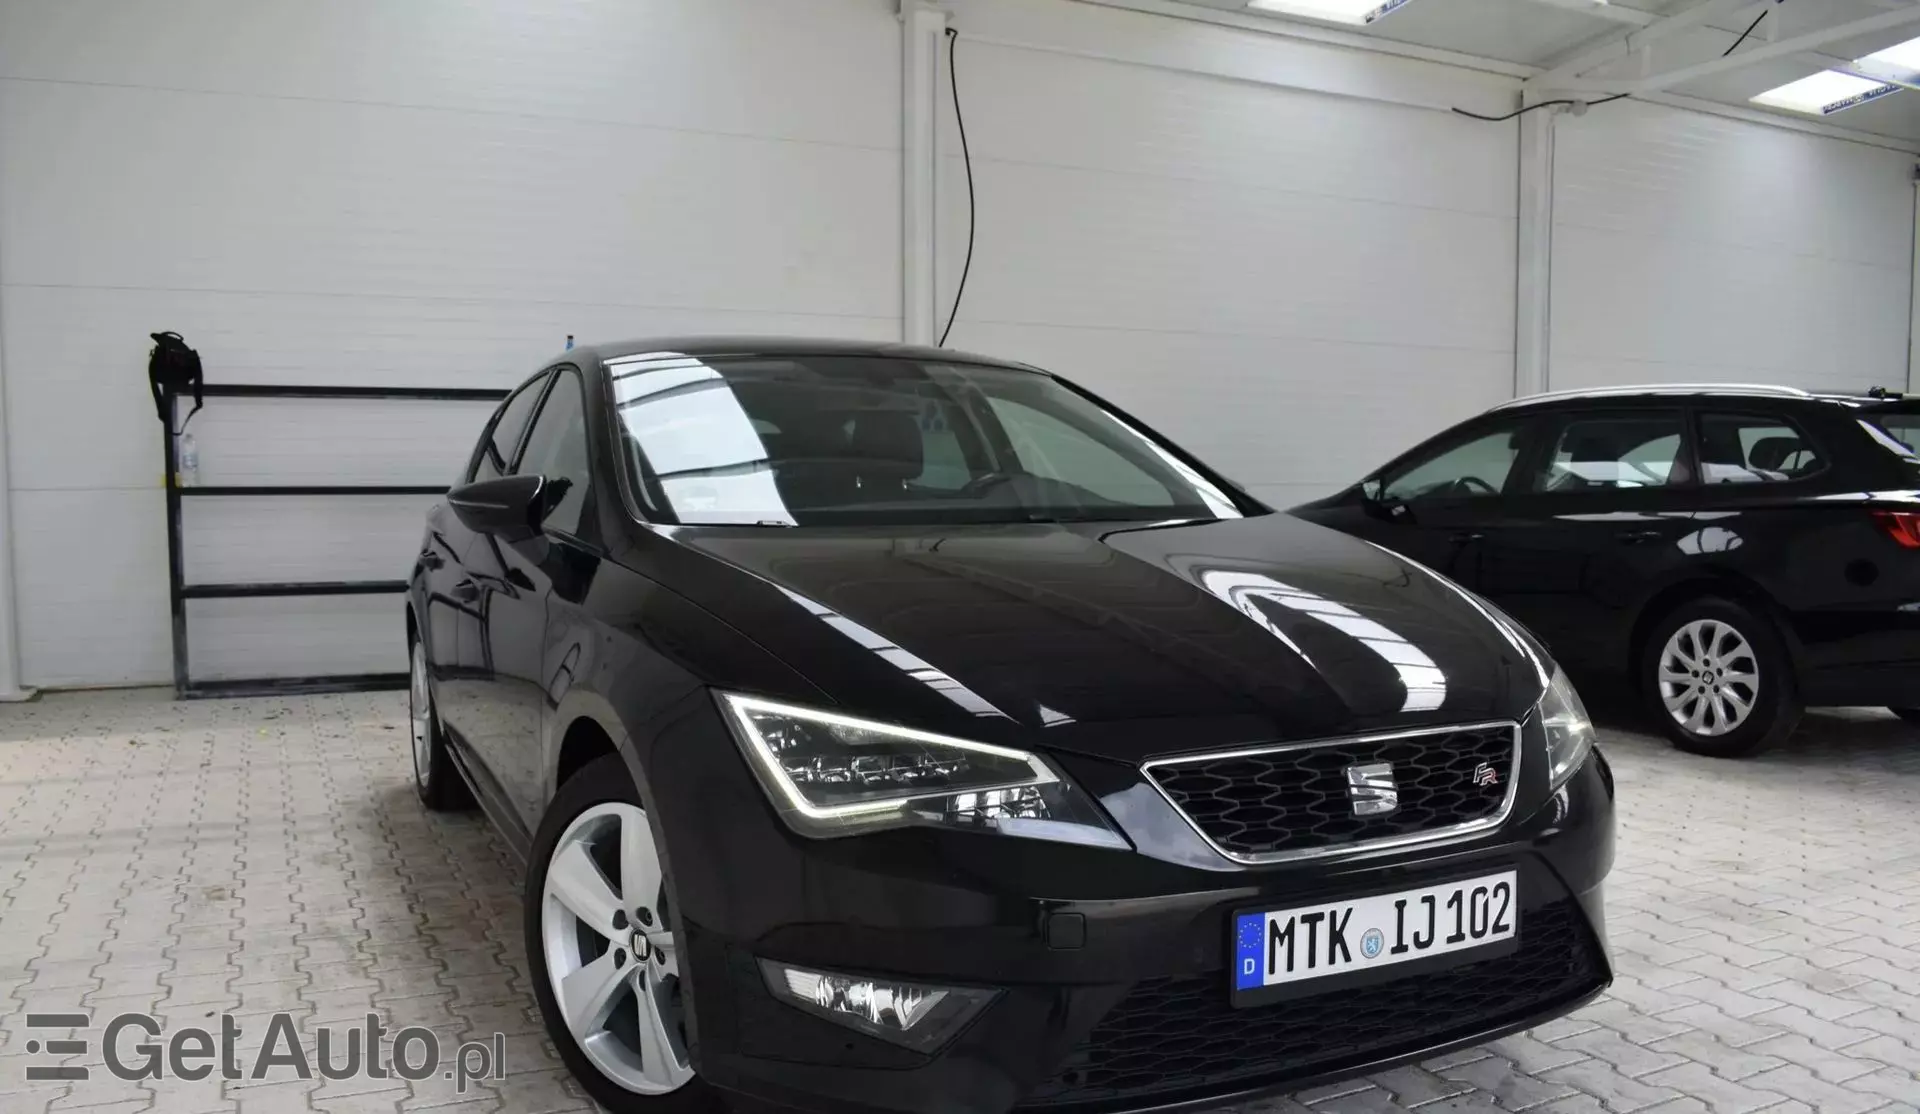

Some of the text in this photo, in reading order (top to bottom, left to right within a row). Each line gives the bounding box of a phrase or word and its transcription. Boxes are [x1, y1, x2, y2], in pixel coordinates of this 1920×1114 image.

[1472, 762, 1498, 786] FR
[1268, 907, 1353, 975] MTK
[1243, 959, 1255, 975] D
